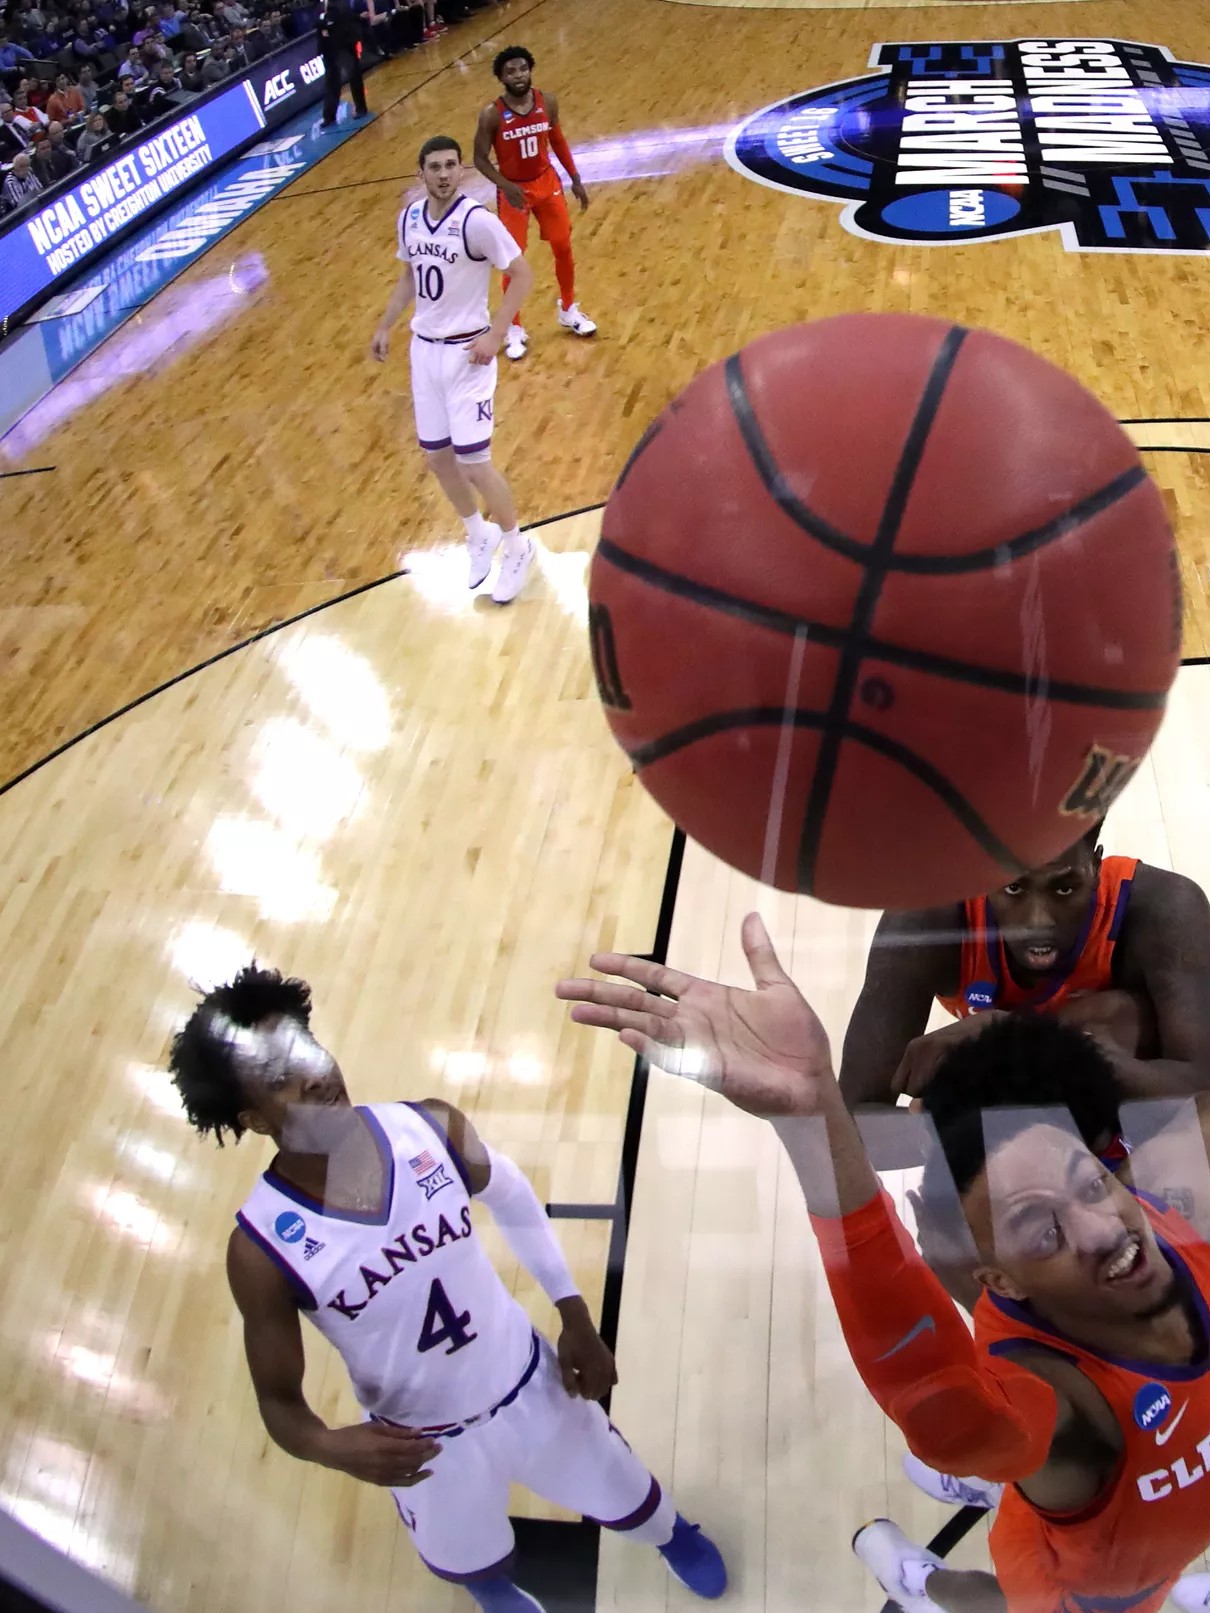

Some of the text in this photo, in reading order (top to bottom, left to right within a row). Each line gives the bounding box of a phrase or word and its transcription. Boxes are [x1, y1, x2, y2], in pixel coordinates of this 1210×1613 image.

[264, 69, 295, 105] ACC
[502, 122, 549, 140] CLEMSON
[895, 41, 1174, 184] MARCH MADNESS
[520, 136, 539, 159] 10
[777, 124, 835, 164] SWEET
[27, 194, 87, 255] NCAA
[80, 154, 142, 217] SWEET
[138, 114, 207, 177] SIXTEEN
[45, 231, 94, 275] HOSTED
[89, 217, 108, 244] BY
[104, 182, 163, 231] CREIGHTON
[157, 143, 213, 193] UNIVERSITY
[949, 189, 985, 226] NCAA
[416, 264, 443, 301] 10
[327, 1205, 472, 1321] KANSAS
[417, 1277, 478, 1355] 4
[1142, 1393, 1171, 1427] NCAA
